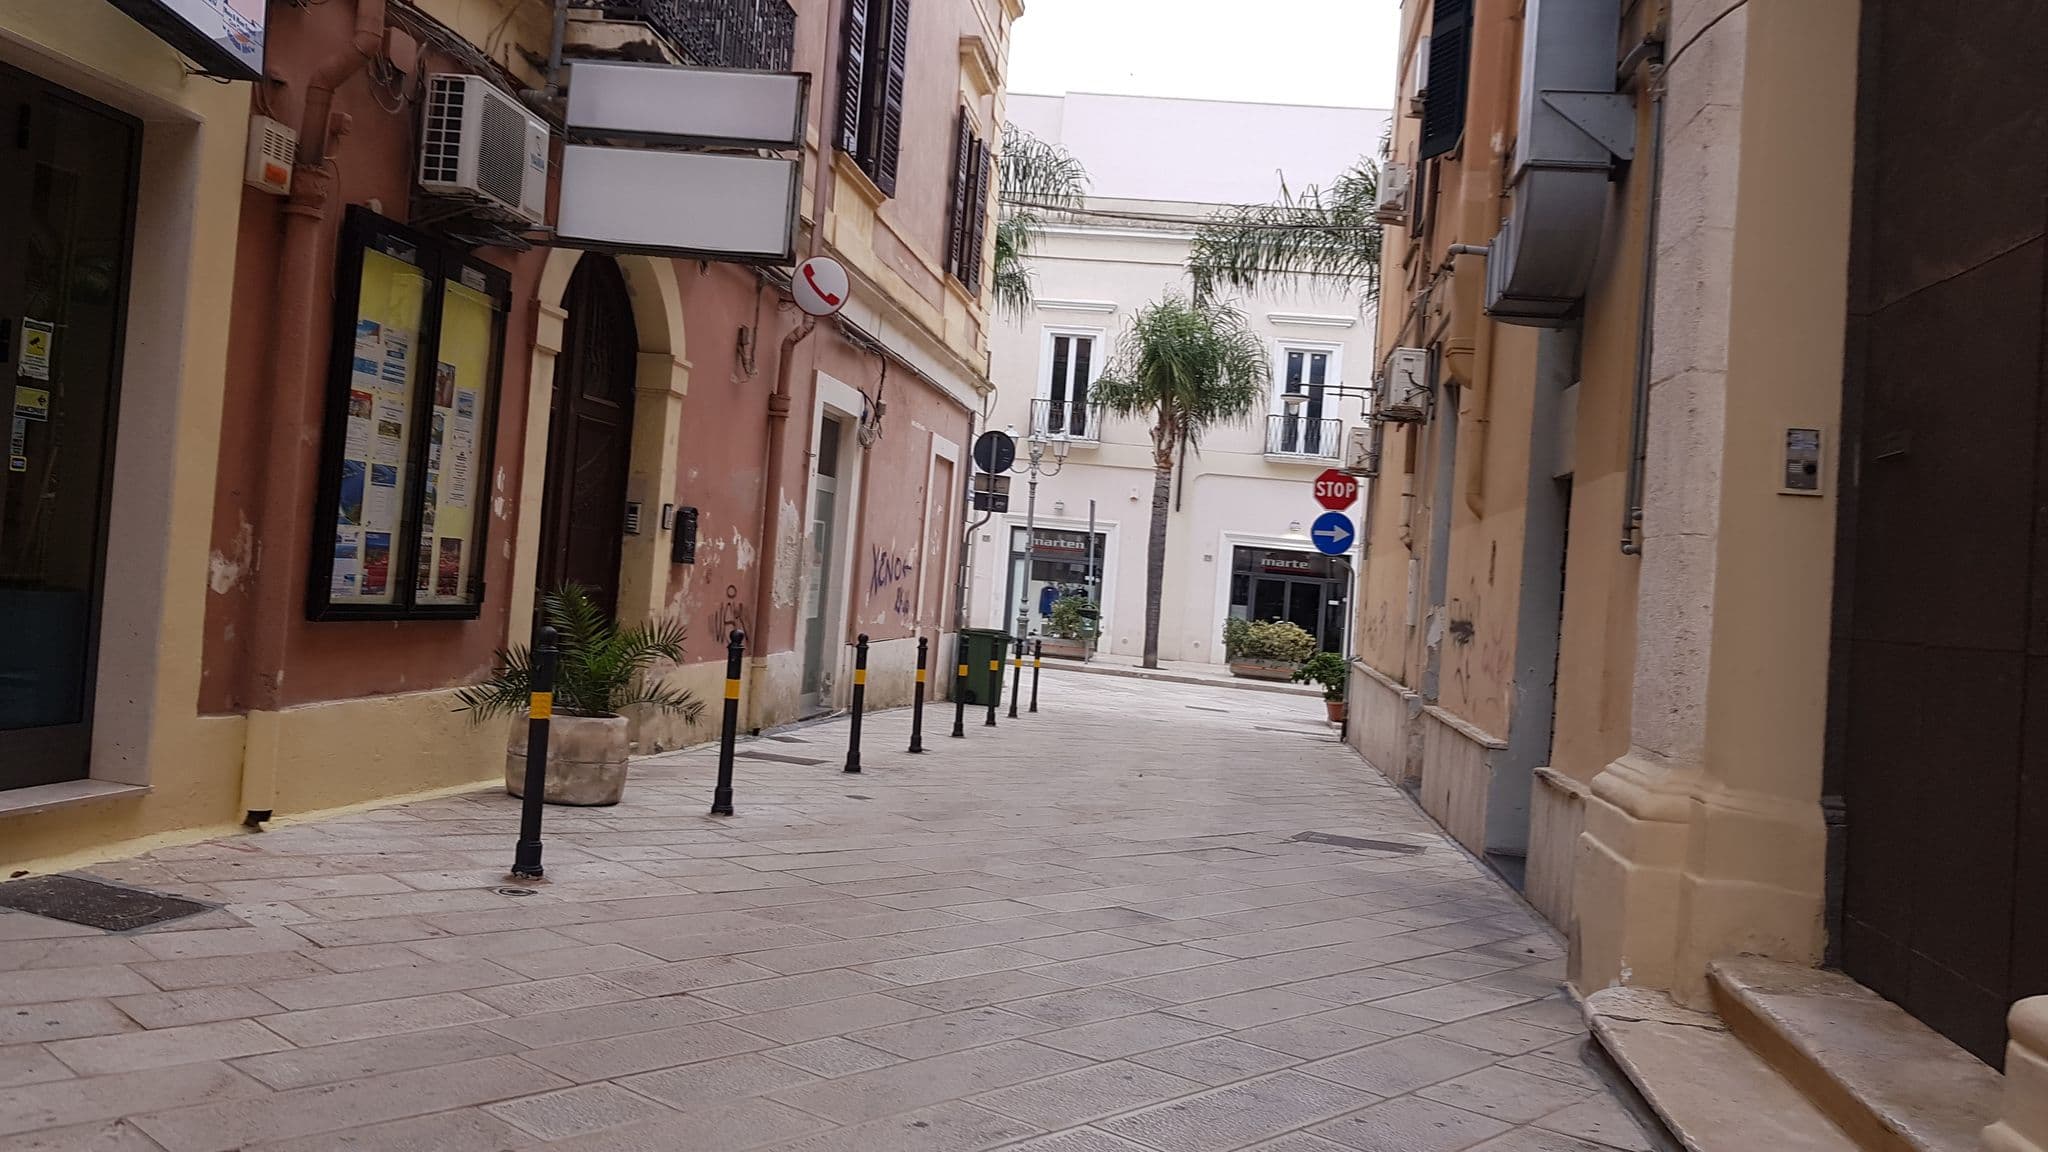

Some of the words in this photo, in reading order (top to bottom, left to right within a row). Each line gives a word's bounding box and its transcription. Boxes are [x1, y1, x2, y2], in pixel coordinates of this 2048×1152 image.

[1316, 481, 1356, 498] STOP
[1031, 538, 1085, 549] marten
[1261, 558, 1312, 570] marte
